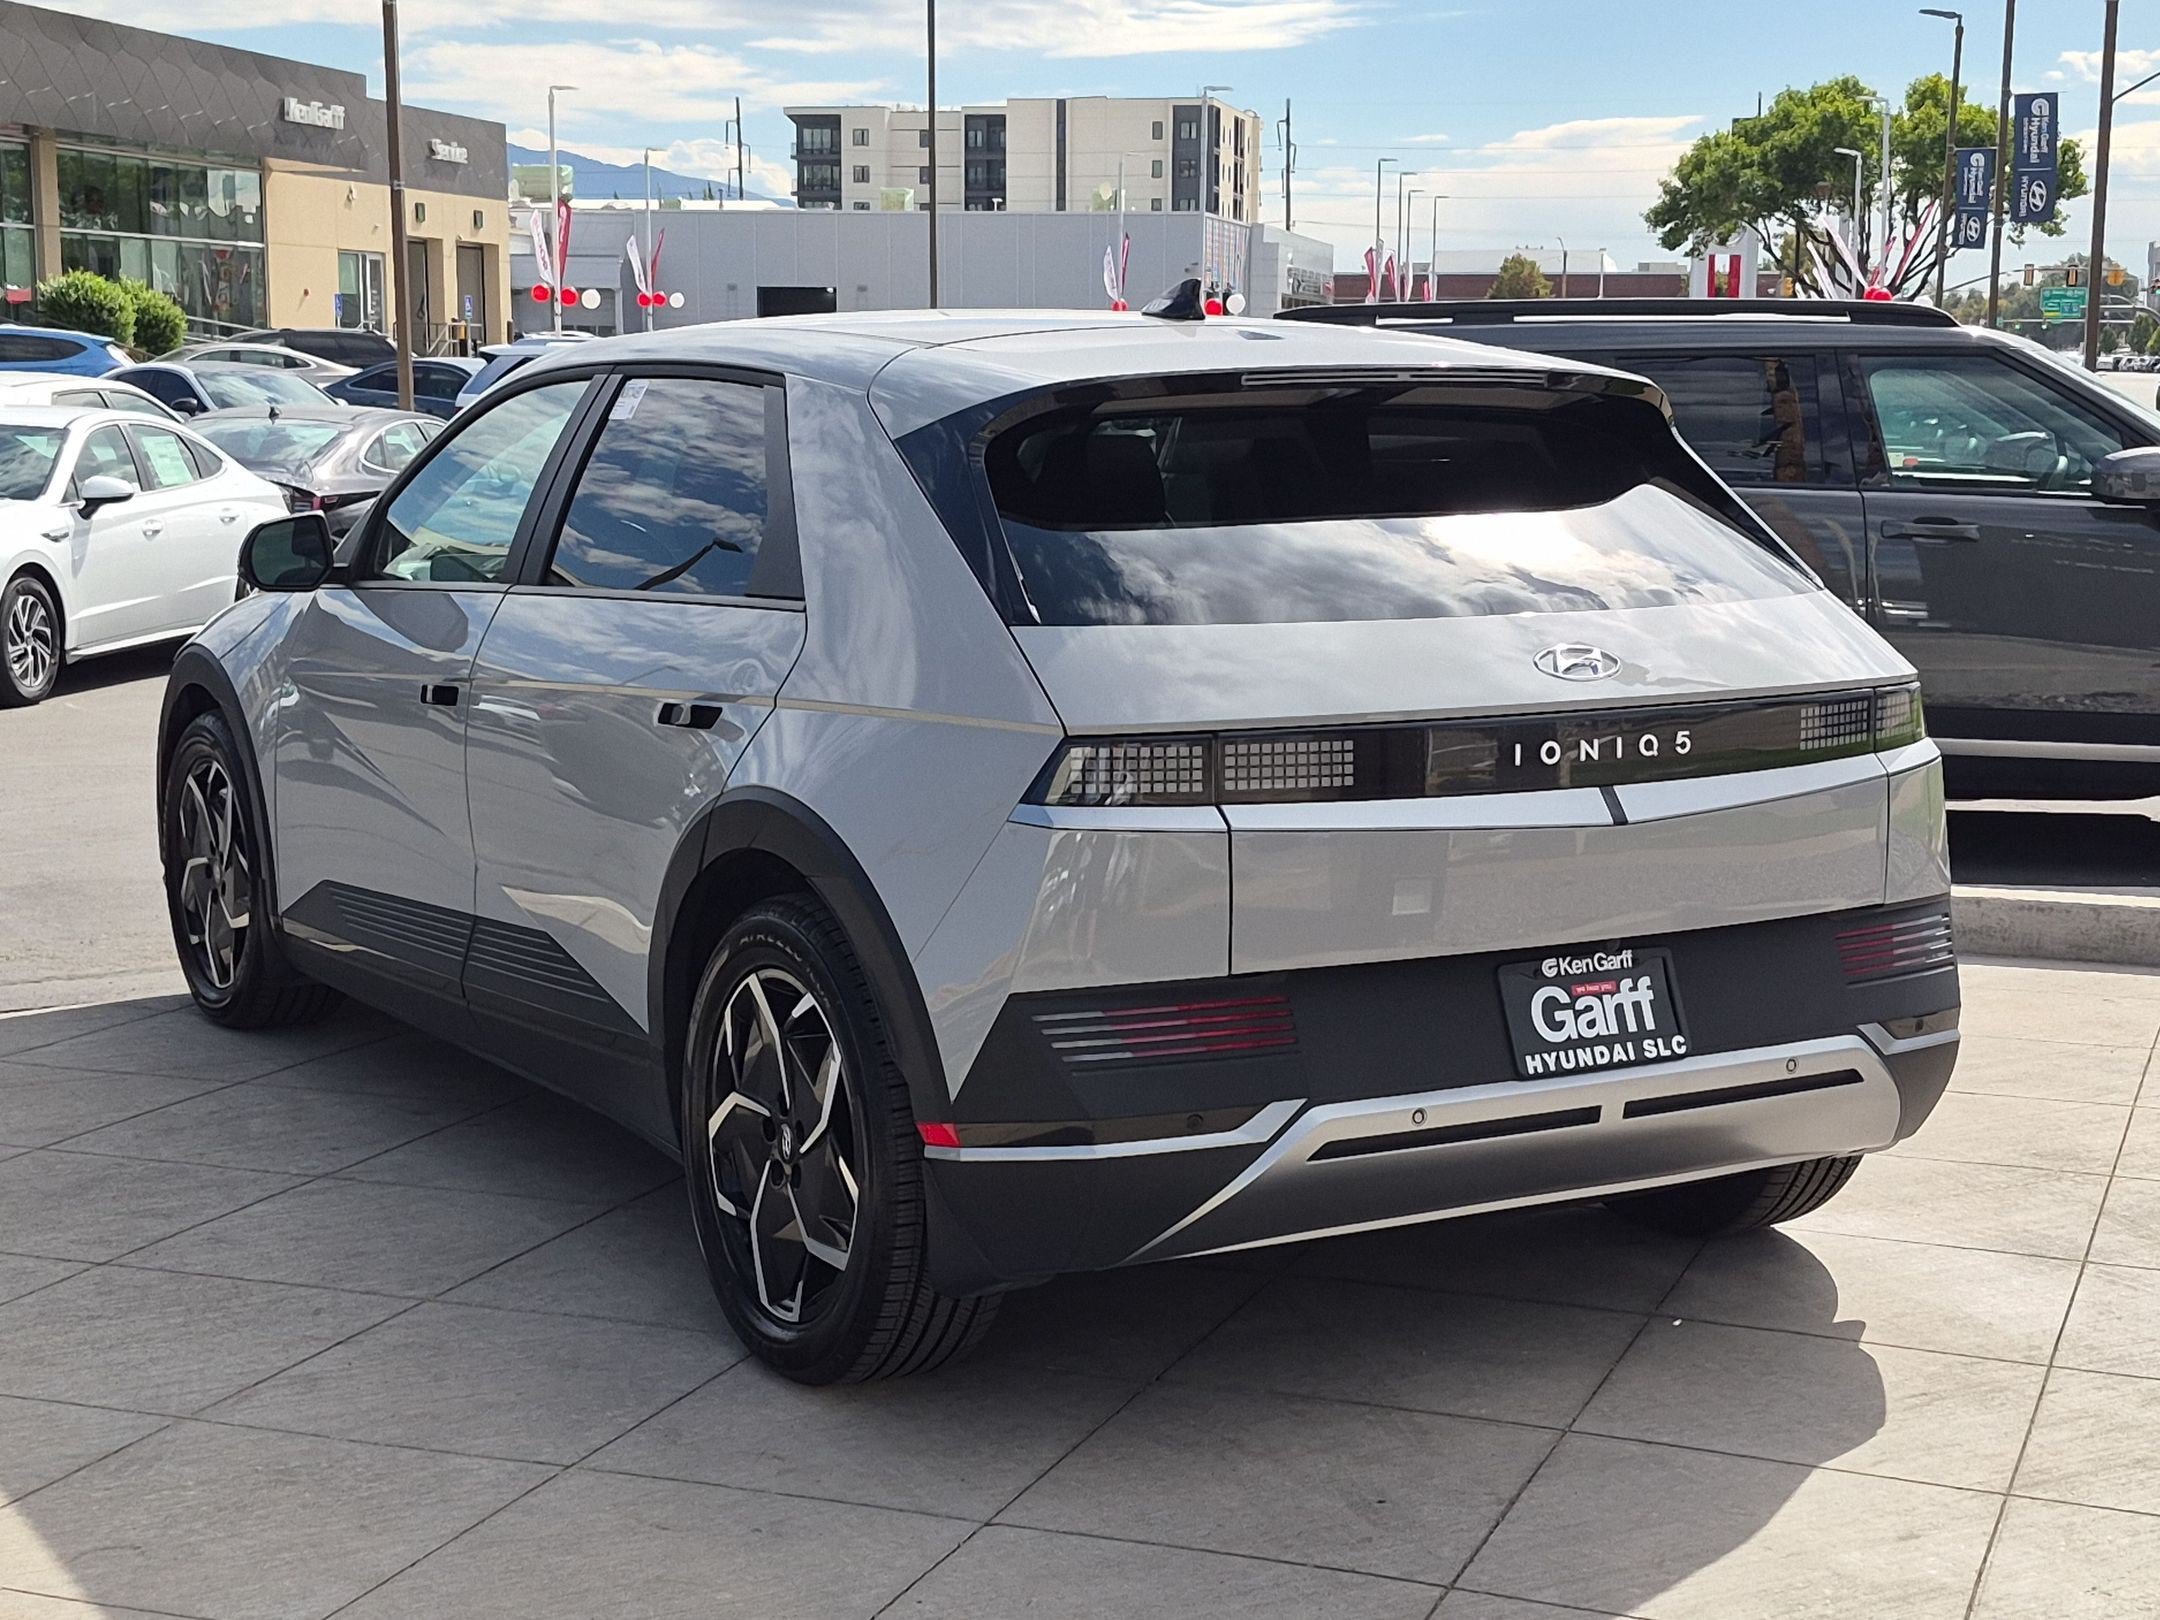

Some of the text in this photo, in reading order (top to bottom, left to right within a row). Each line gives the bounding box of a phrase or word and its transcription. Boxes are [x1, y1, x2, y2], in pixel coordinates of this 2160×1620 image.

[2029, 117, 2040, 163] Hyundai
[2019, 175, 2028, 217] HYUNDAI
[1531, 976, 1656, 1043] Garff
[1525, 1035, 1687, 1075] HYUNDAI SLC
